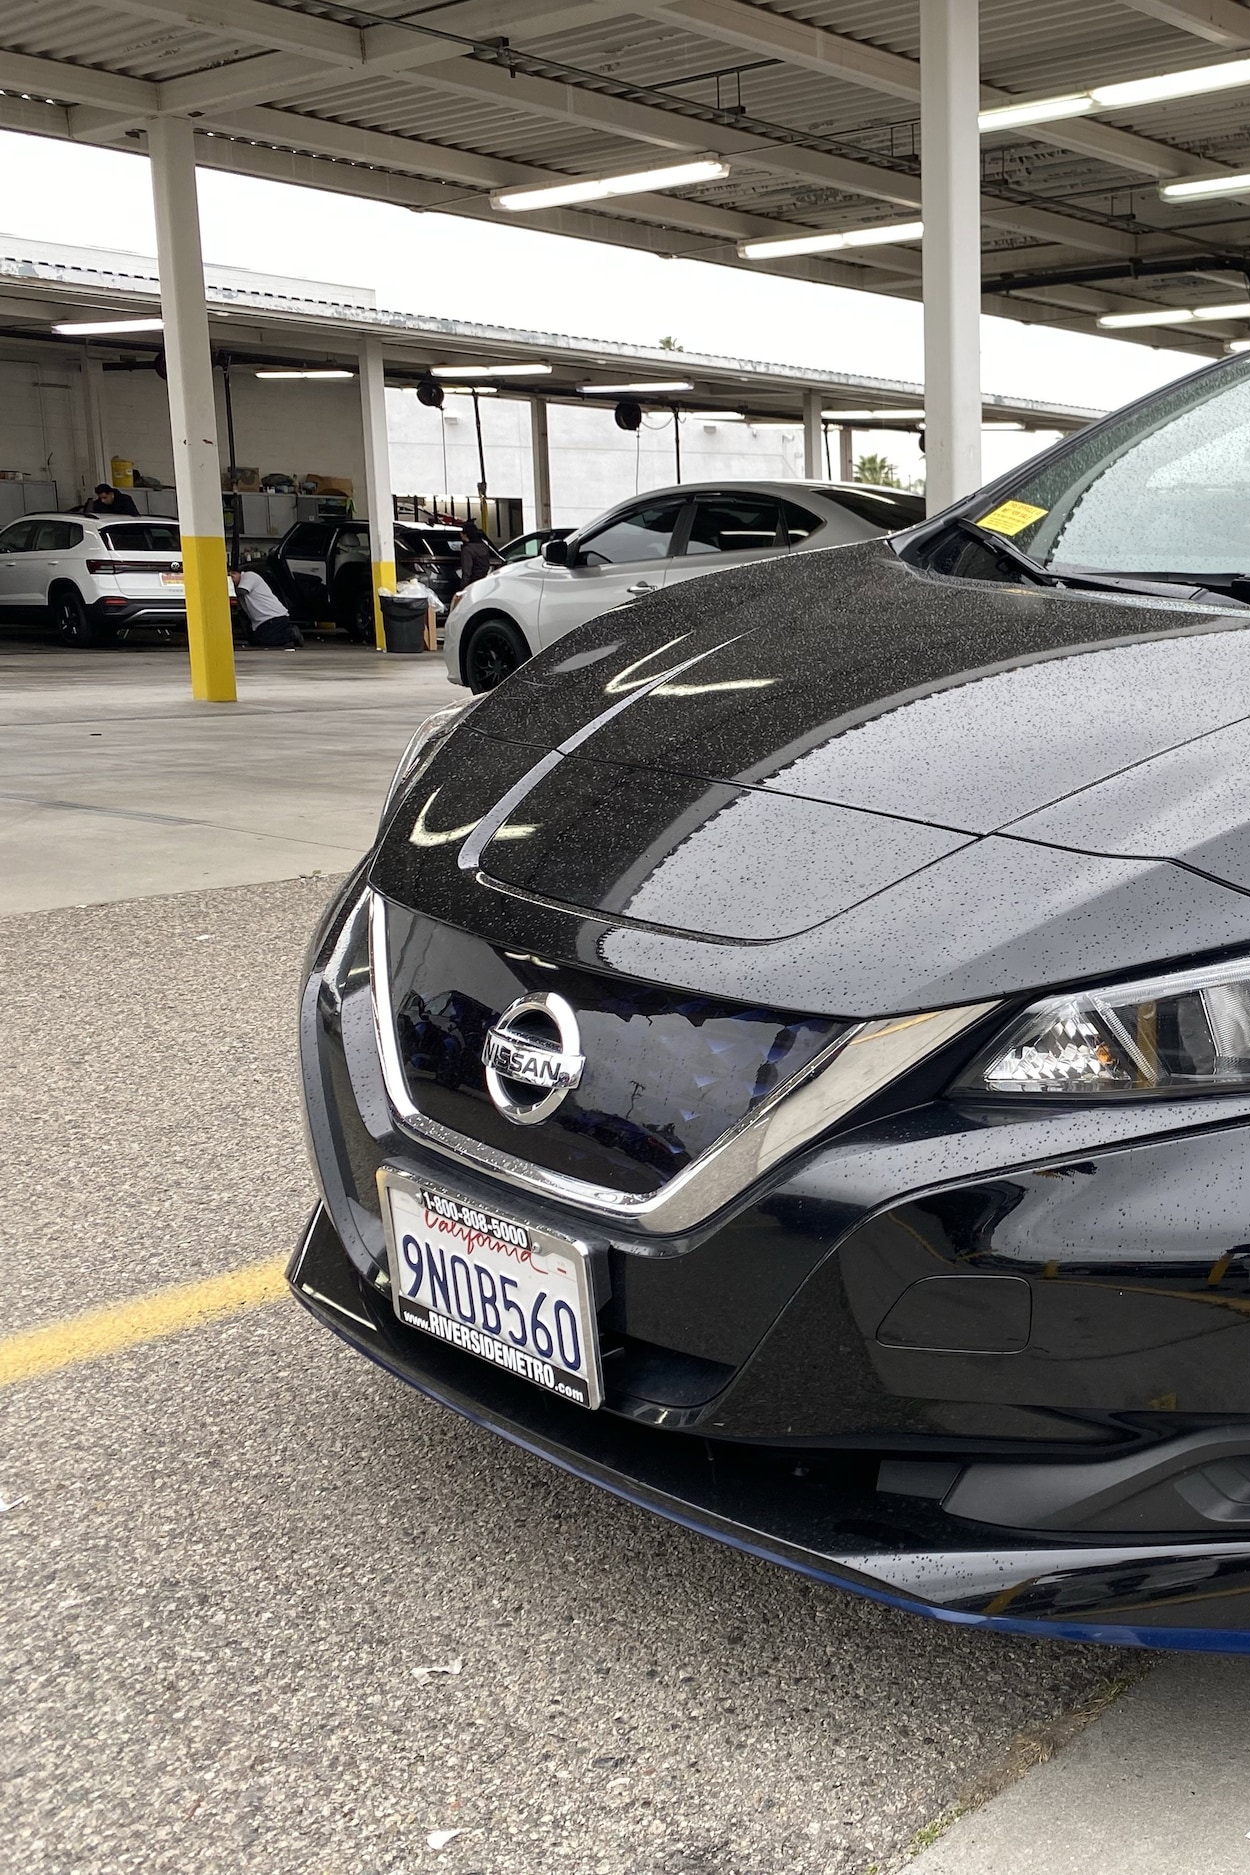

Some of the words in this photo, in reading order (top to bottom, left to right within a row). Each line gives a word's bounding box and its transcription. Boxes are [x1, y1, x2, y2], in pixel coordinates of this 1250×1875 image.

[486, 1034, 562, 1081] NISSAN
[423, 1191, 528, 1248] 1-800-808-5000
[402, 1234, 582, 1371] 9NOB560
[403, 1311, 584, 1403] www.RIVERSIDEMETRO.com
